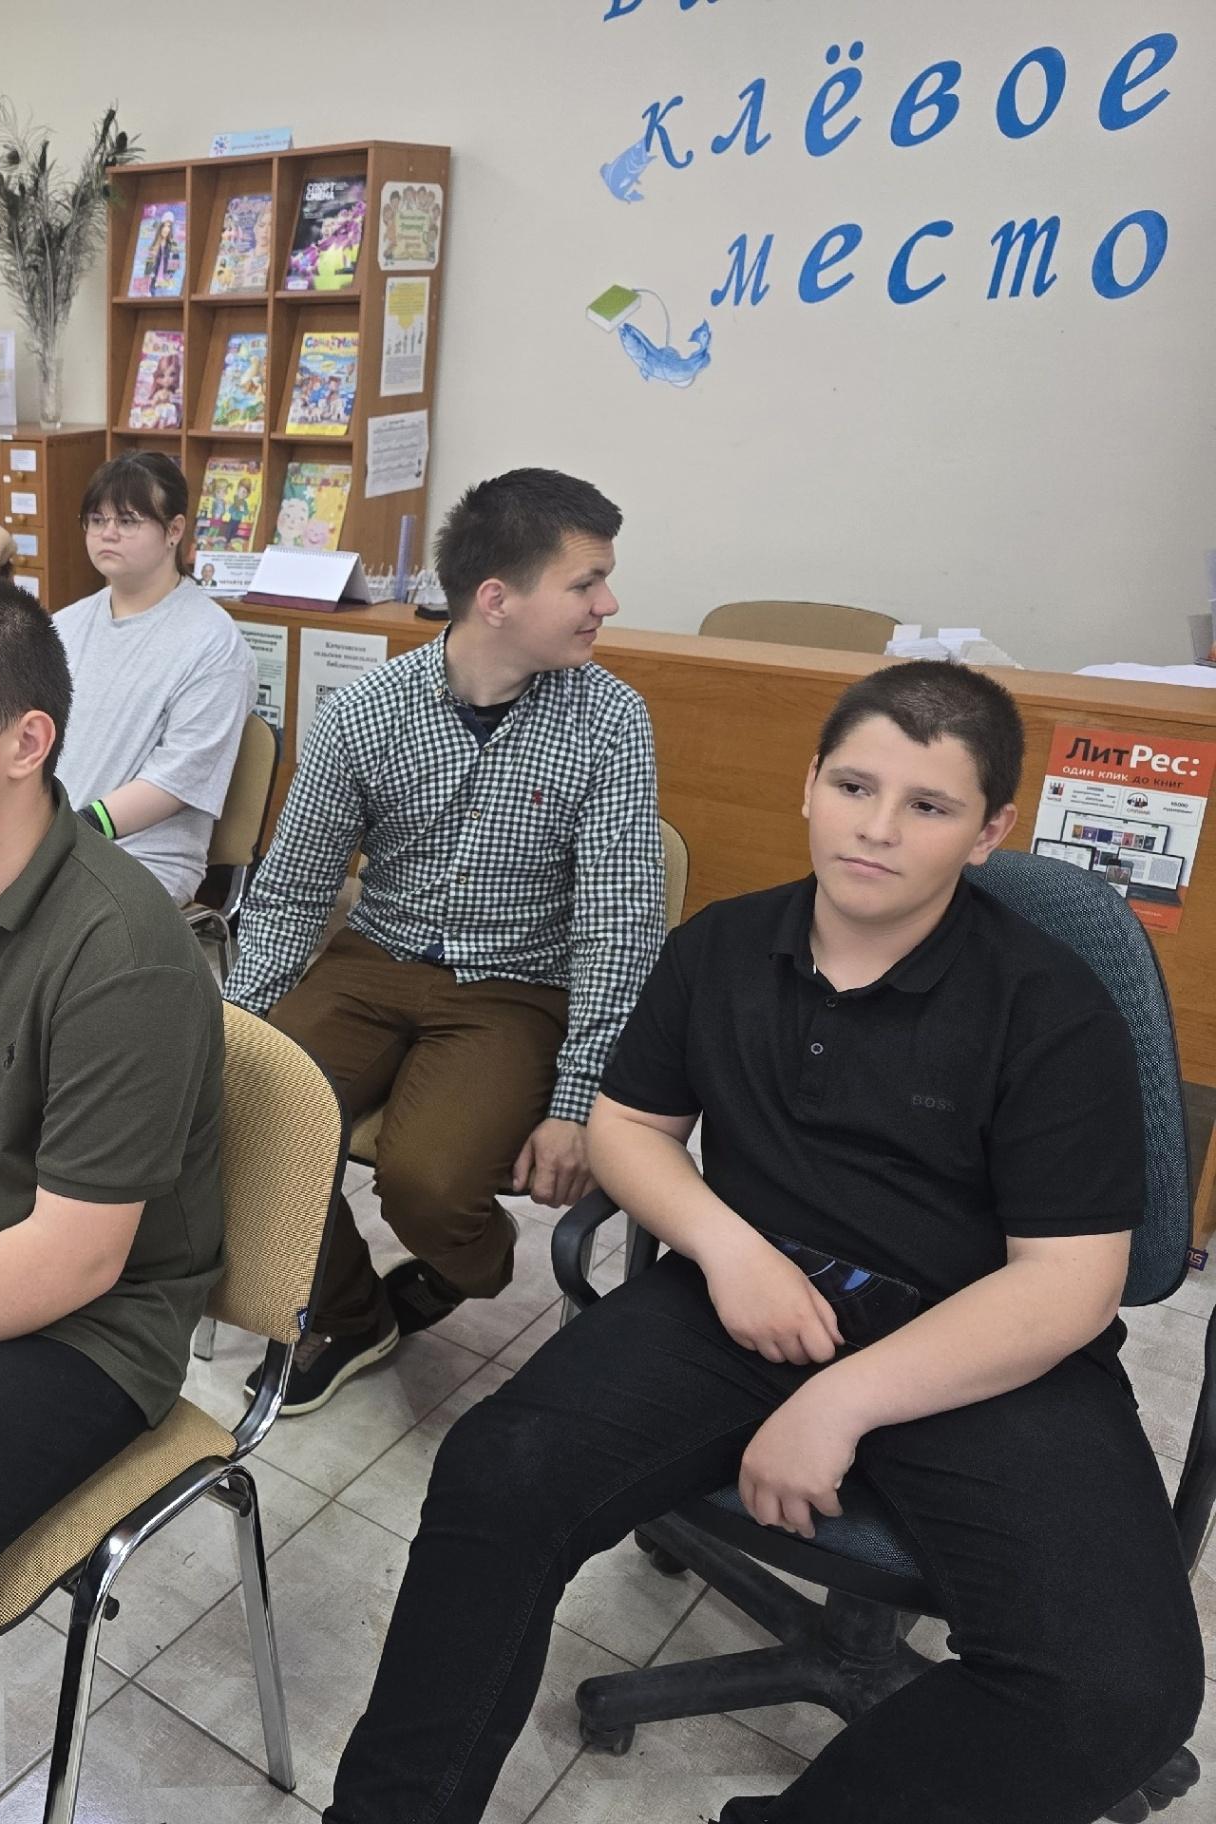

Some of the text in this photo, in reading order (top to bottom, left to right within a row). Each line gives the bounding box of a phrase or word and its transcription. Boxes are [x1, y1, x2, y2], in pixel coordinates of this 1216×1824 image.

[640, 32, 1179, 170] клёвое
[710, 208, 1169, 308] место
[1062, 765, 1184, 789] один клик до книг
[1066, 737, 1200, 777] ЛитРес:
[912, 1094, 956, 1113] BOSS
